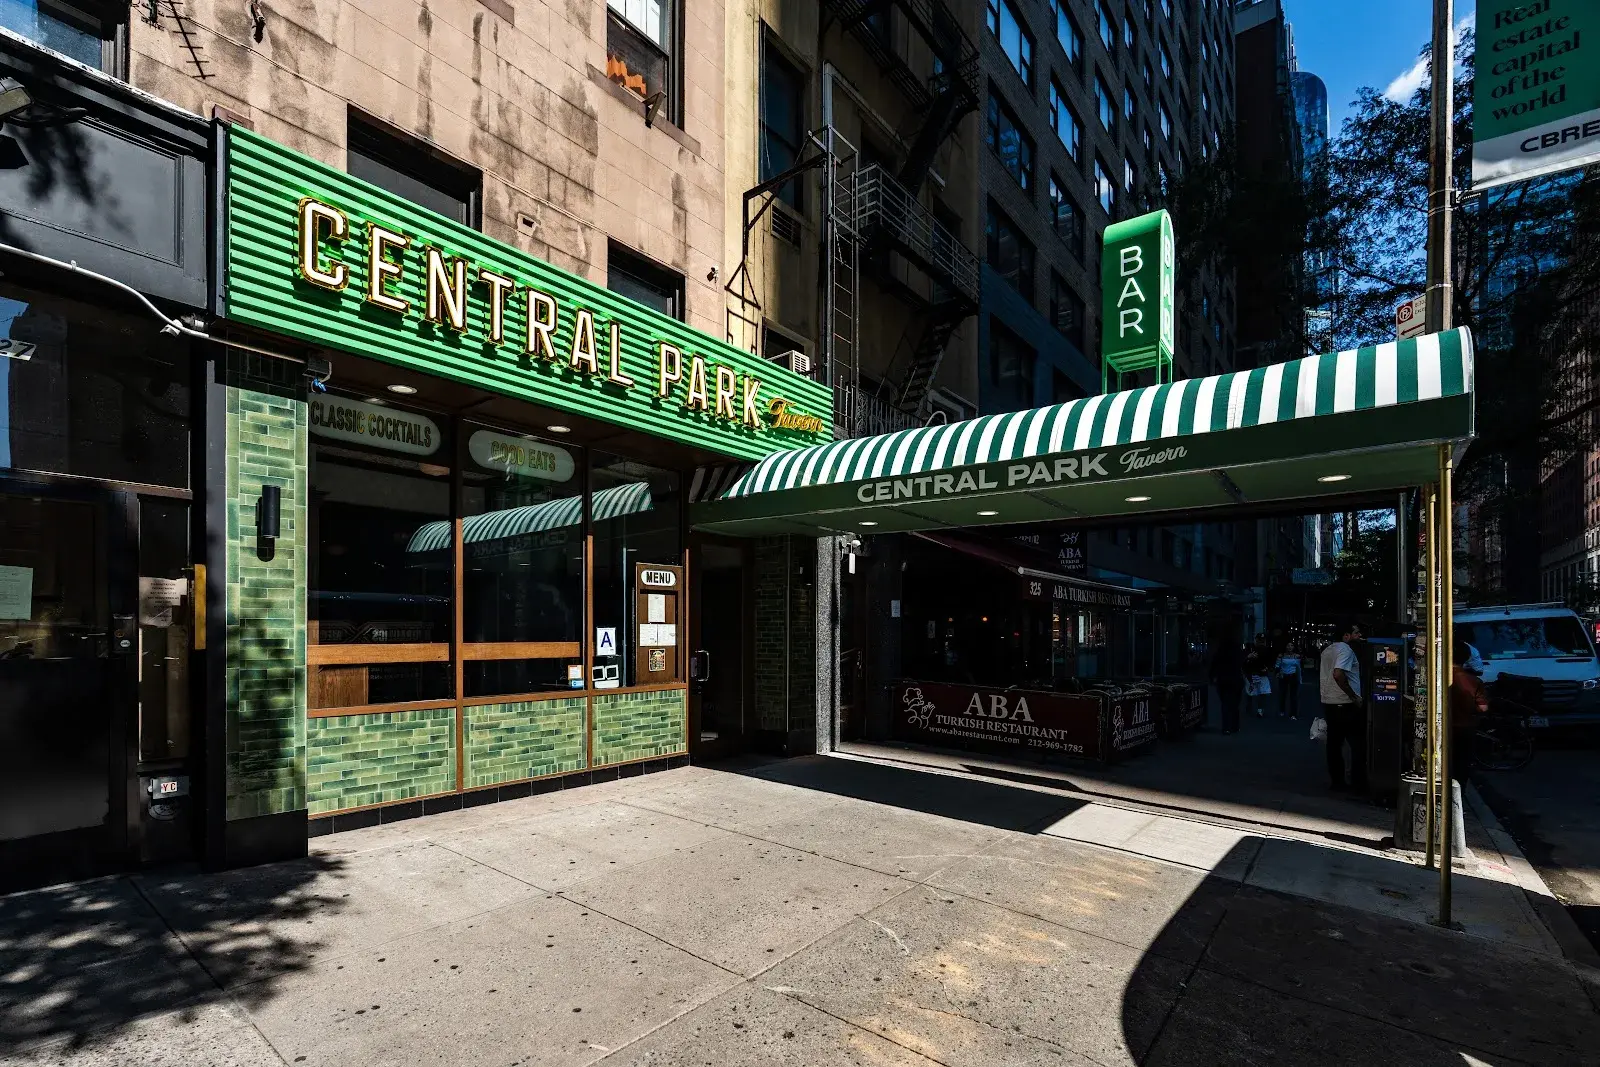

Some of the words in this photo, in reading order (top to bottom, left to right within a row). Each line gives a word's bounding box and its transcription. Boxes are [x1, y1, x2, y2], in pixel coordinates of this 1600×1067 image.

[1493, 0, 1550, 29] Real
[1491, 15, 1570, 52] estate
[1491, 31, 1580, 76] capital
[1491, 75, 1521, 98] of
[1522, 65, 1566, 90] the
[1491, 84, 1566, 120] world
[1520, 119, 1600, 152] CBRE
[1117, 245, 1146, 338] BAR
[298, 196, 634, 388] CENTRAL
[657, 340, 763, 430] PARK
[766, 397, 824, 432] Tavern
[310, 400, 366, 434] CLASSIC
[367, 413, 431, 448] COCKTAILS
[490, 440, 526, 467] GOOD
[528, 451, 556, 472] EATS
[857, 469, 998, 503] CENTRAL
[1008, 452, 1109, 487] PARK
[1119, 445, 1188, 474] Tavern
[1058, 547, 1083, 559] ABA
[646, 571, 671, 584] MENU
[1029, 581, 1042, 596] 325
[1053, 585, 1068, 600] ABA
[1069, 587, 1097, 604] TURKISH
[600, 631, 612, 648] A
[963, 692, 1034, 723] ABA
[928, 726, 1020, 745] www.abarestaurant.com
[1027, 738, 1083, 754] 212-969-1782
[935, 714, 985, 731] TURKISH
[986, 721, 1068, 741] RESTAURANT
